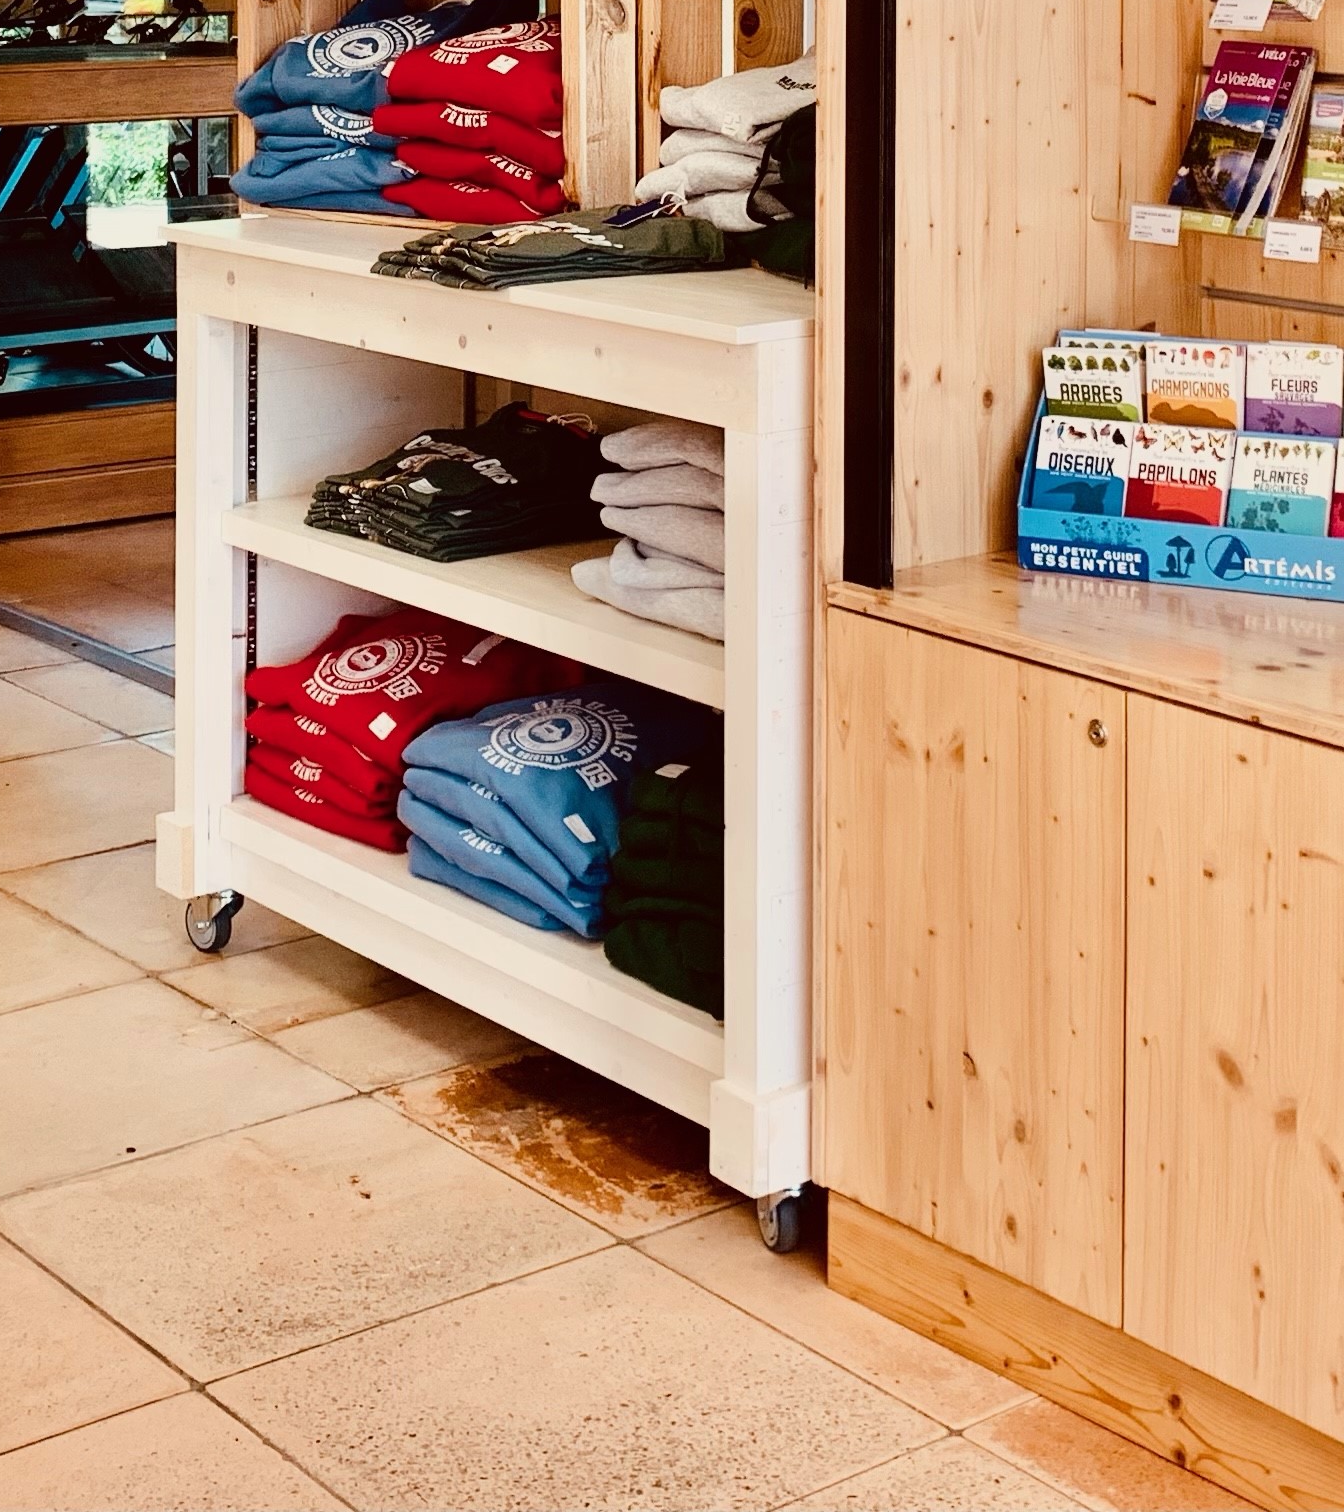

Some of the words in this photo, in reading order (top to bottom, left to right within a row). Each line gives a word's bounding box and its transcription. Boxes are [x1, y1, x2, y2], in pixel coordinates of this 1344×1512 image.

[430, 49, 470, 65] FRANCE
[1215, 70, 1227, 84] La
[1228, 71, 1248, 87] Voie
[1247, 73, 1277, 90] Bleue
[440, 107, 488, 128] FRANCE
[1060, 383, 1123, 404] ARBRES
[1151, 379, 1230, 398] CHAMPIGNONS
[1271, 379, 1318, 394] FLEURS
[1274, 393, 1314, 402] SAUVAGES
[1049, 452, 1115, 476] OISEAUX
[1139, 463, 1217, 486] PAPILLONS
[1253, 469, 1308, 486] PLANTES
[1031, 542, 1058, 554] MON
[1063, 546, 1098, 559] PETIT
[1103, 550, 1142, 564] GUIDE
[1034, 553, 1140, 576] ESSENTIEL
[302, 678, 340, 707] FRANCE
[333, 678, 378, 690] ORIGINAL
[478, 744, 525, 776] FRANCE
[516, 750, 568, 765] ORIGINAL
[290, 759, 323, 782] FRANCE
[459, 829, 505, 856] FRANCE
